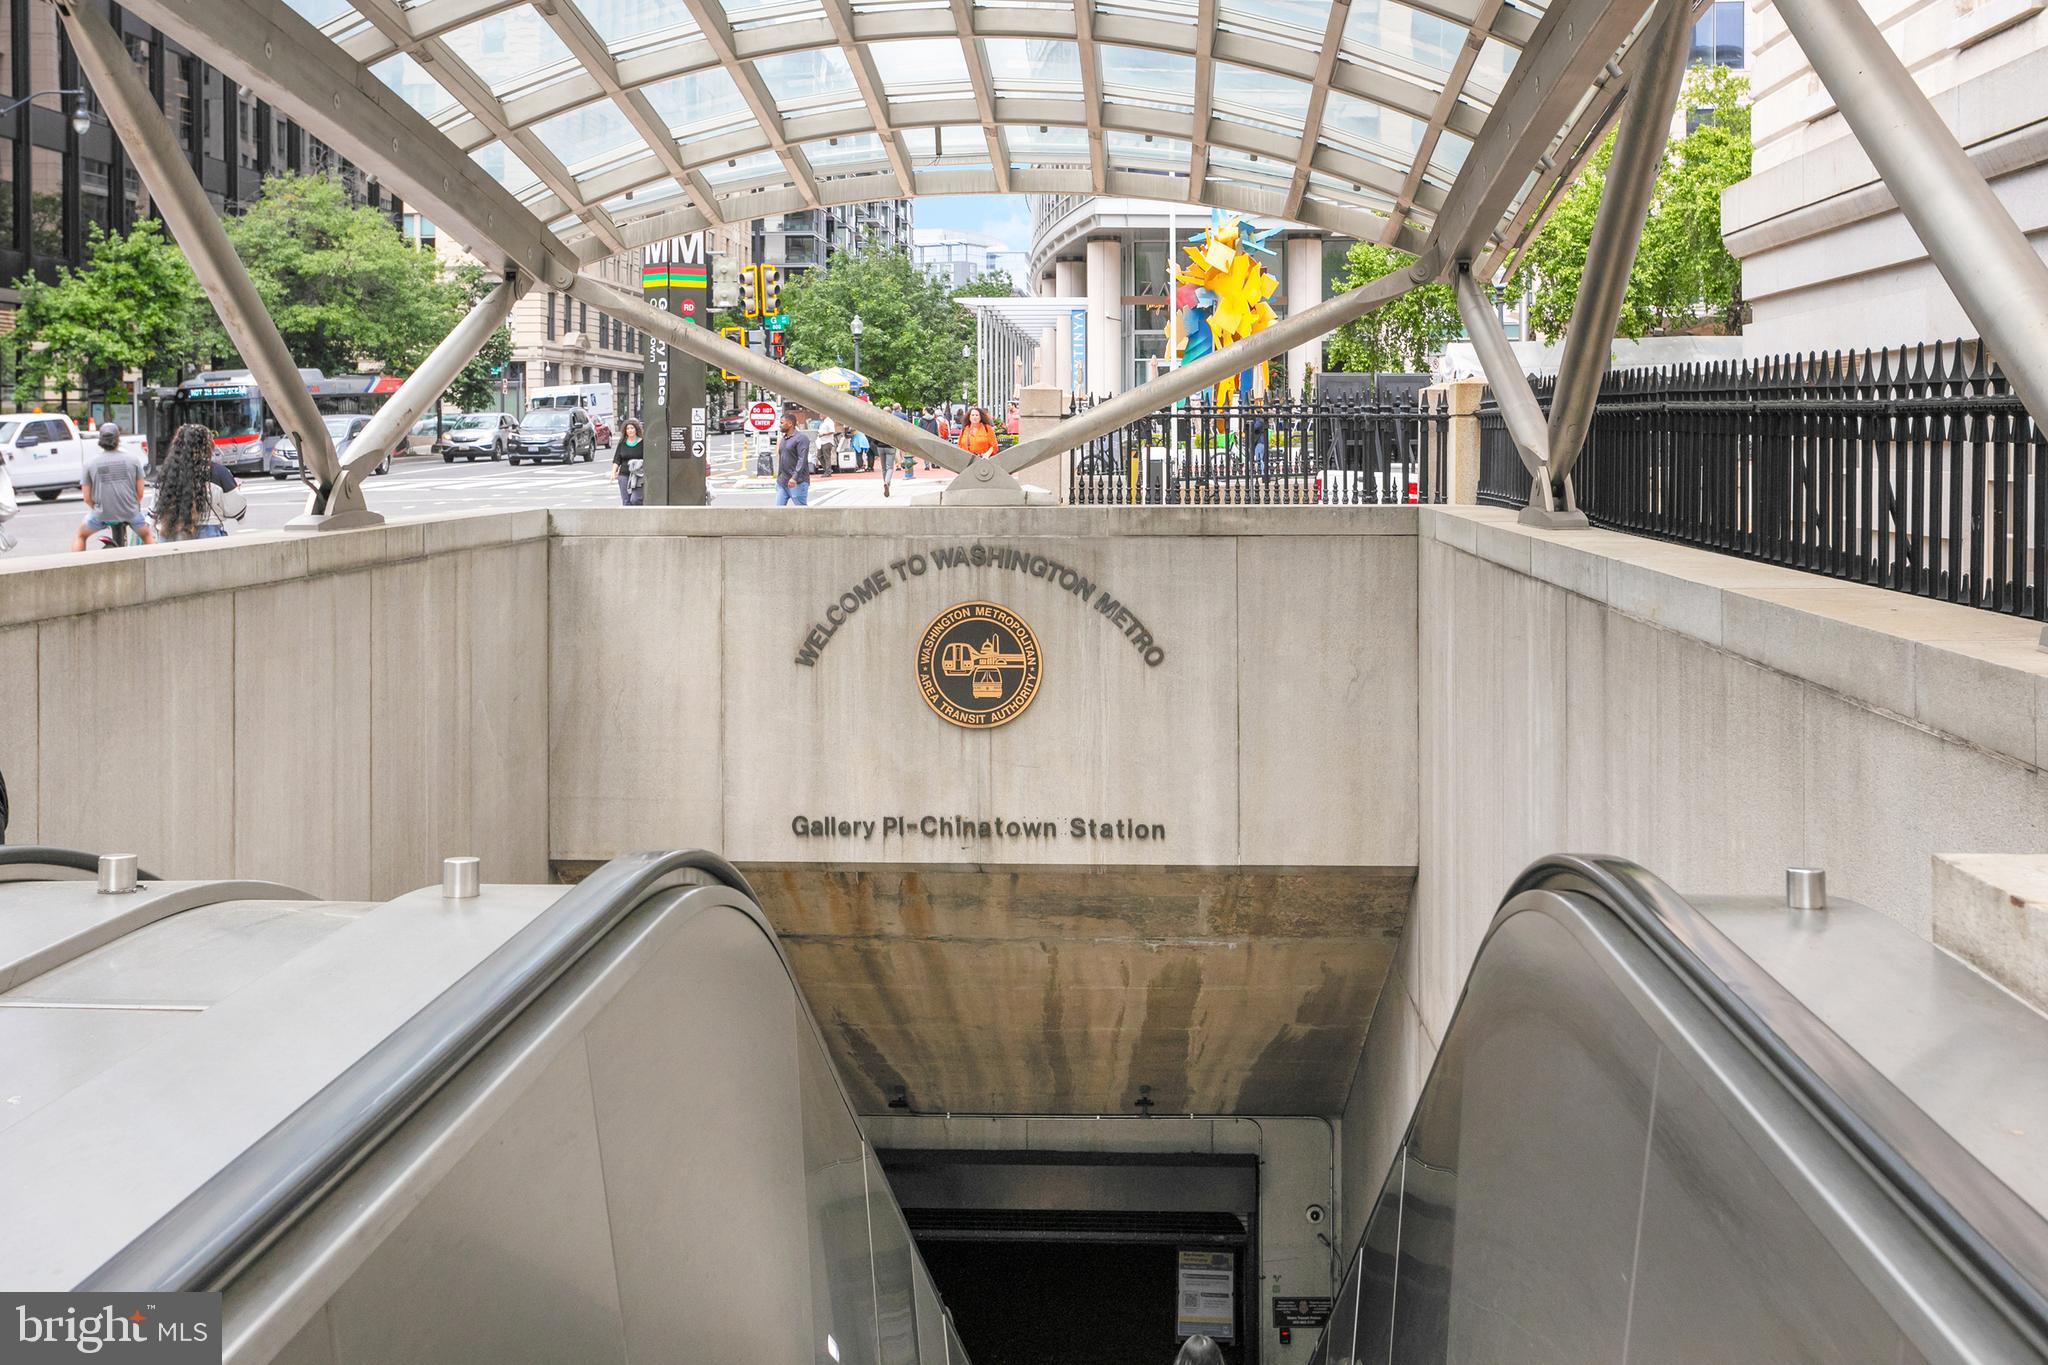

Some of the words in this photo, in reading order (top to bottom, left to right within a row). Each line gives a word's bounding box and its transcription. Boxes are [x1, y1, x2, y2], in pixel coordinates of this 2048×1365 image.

[683, 303, 694, 311] RD
[770, 316, 777, 324] G
[658, 360, 668, 406] Place
[795, 570, 892, 668] WELCOME
[891, 554, 927, 582] TO
[930, 545, 1096, 602] WASHINGTON
[1093, 592, 1165, 668] METRO
[920, 607, 971, 665] WASHINGTON
[975, 606, 1037, 665] METROPOLITAN
[920, 673, 940, 704] AREA
[940, 701, 986, 724] TRANSIT
[991, 673, 1037, 723] AUTHORITY
[791, 815, 875, 840] Gallery
[1070, 816, 1165, 840] Station
